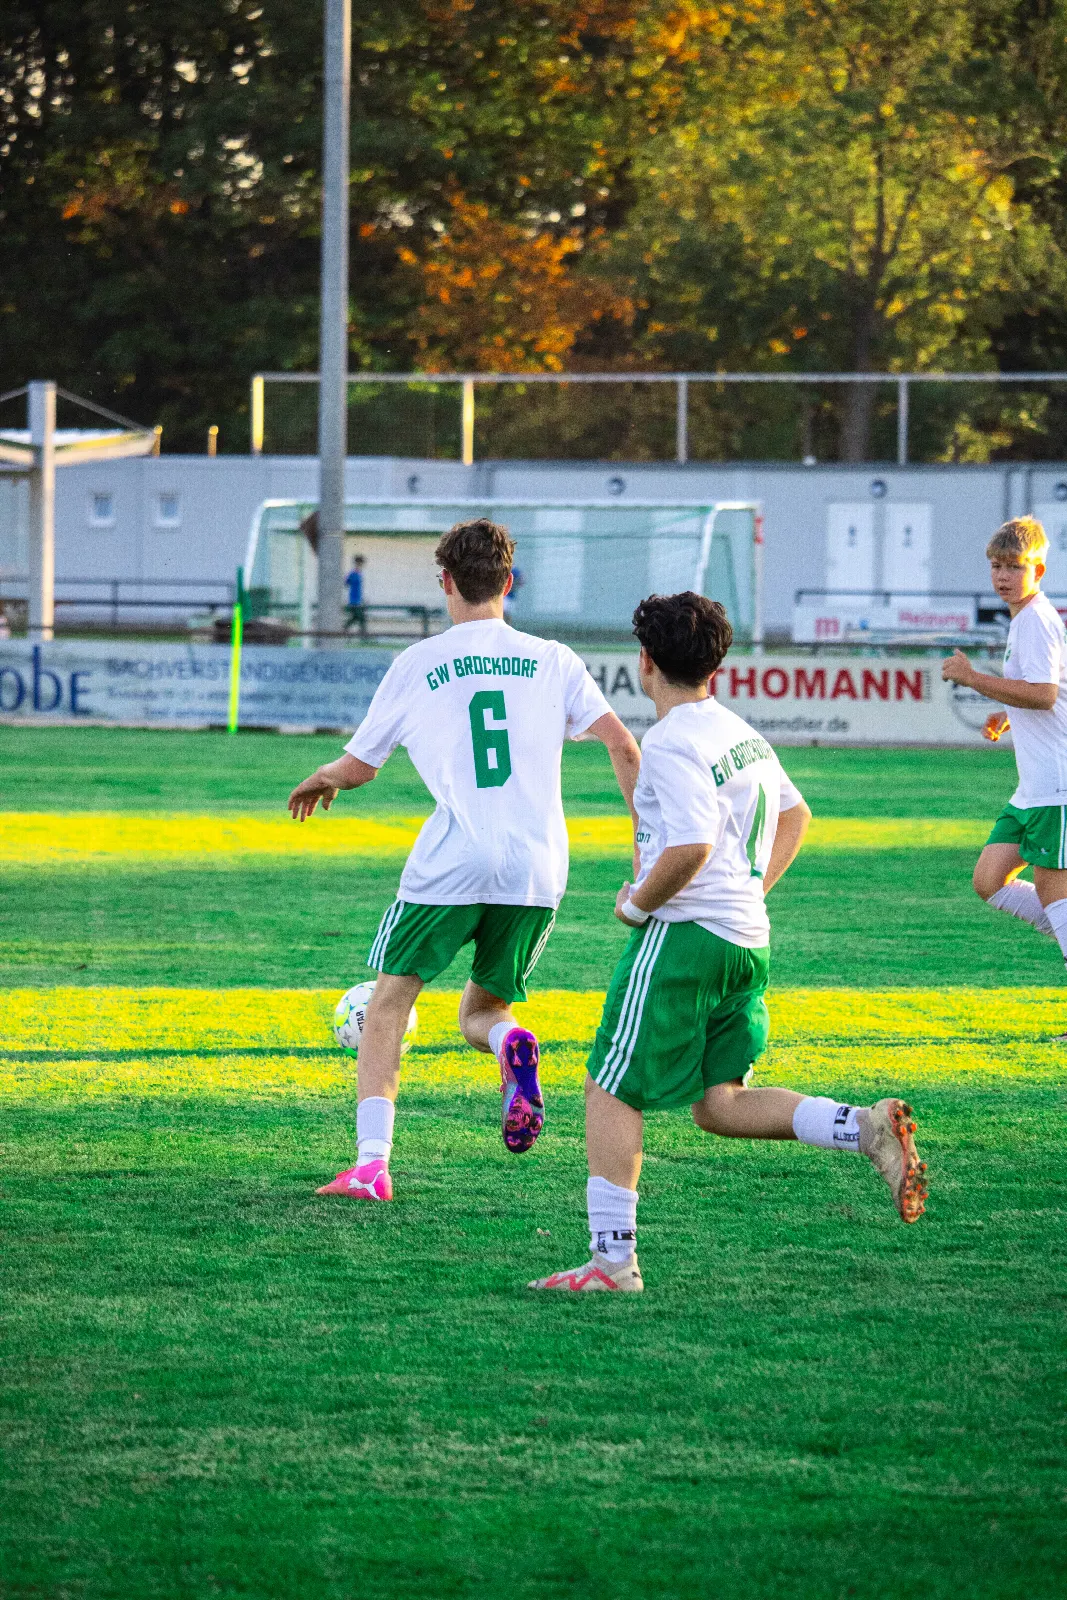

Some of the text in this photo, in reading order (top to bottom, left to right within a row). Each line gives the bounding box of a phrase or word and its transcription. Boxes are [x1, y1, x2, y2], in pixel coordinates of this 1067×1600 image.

[426, 655, 538, 691] GW BROCKDORF
[707, 667, 924, 702] THOMANN
[469, 690, 512, 789] 6
[711, 754, 733, 787] GW
